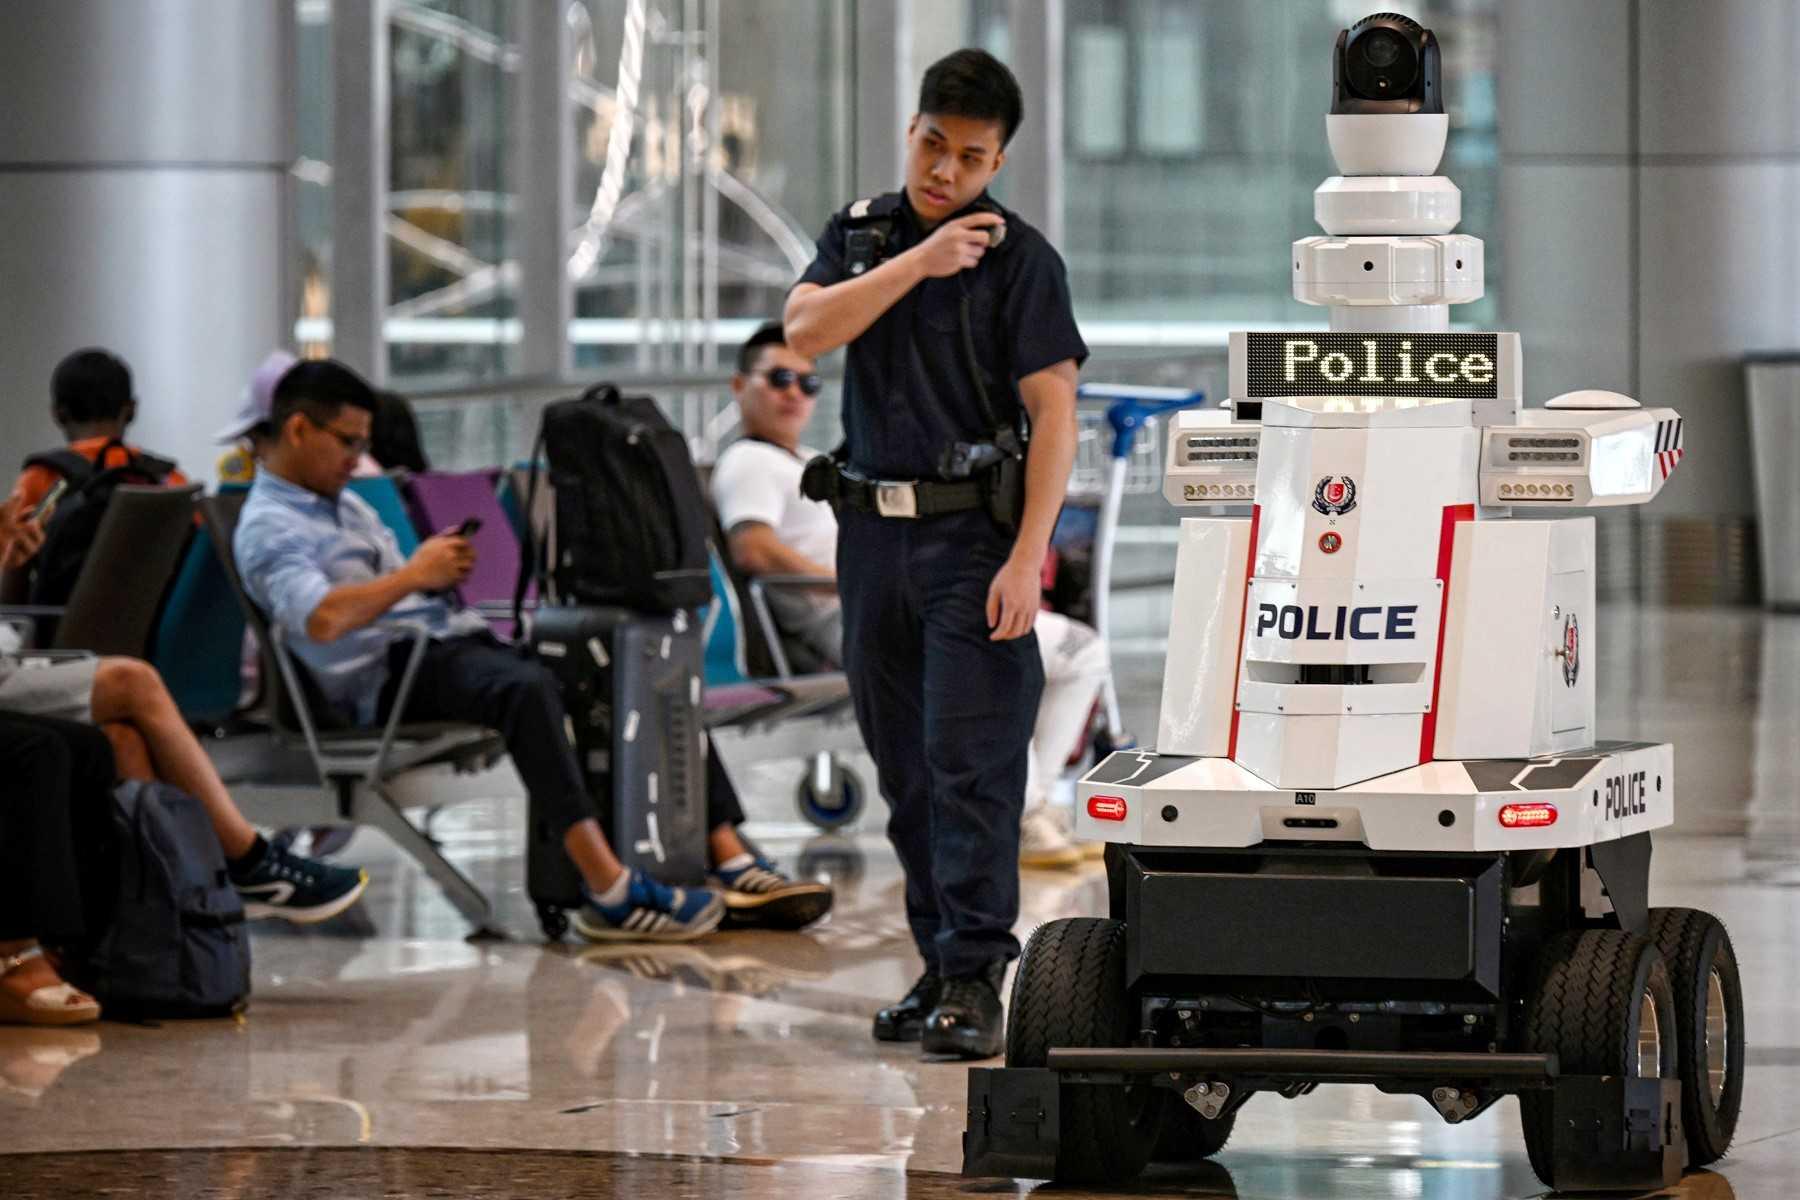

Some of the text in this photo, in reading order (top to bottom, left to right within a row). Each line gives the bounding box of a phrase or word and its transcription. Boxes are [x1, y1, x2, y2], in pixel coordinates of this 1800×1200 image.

[1284, 340, 1494, 383] Police
[1256, 603, 1418, 640] POLICE
[1296, 793, 1316, 804] A10
[1605, 771, 1646, 821] POLICE
